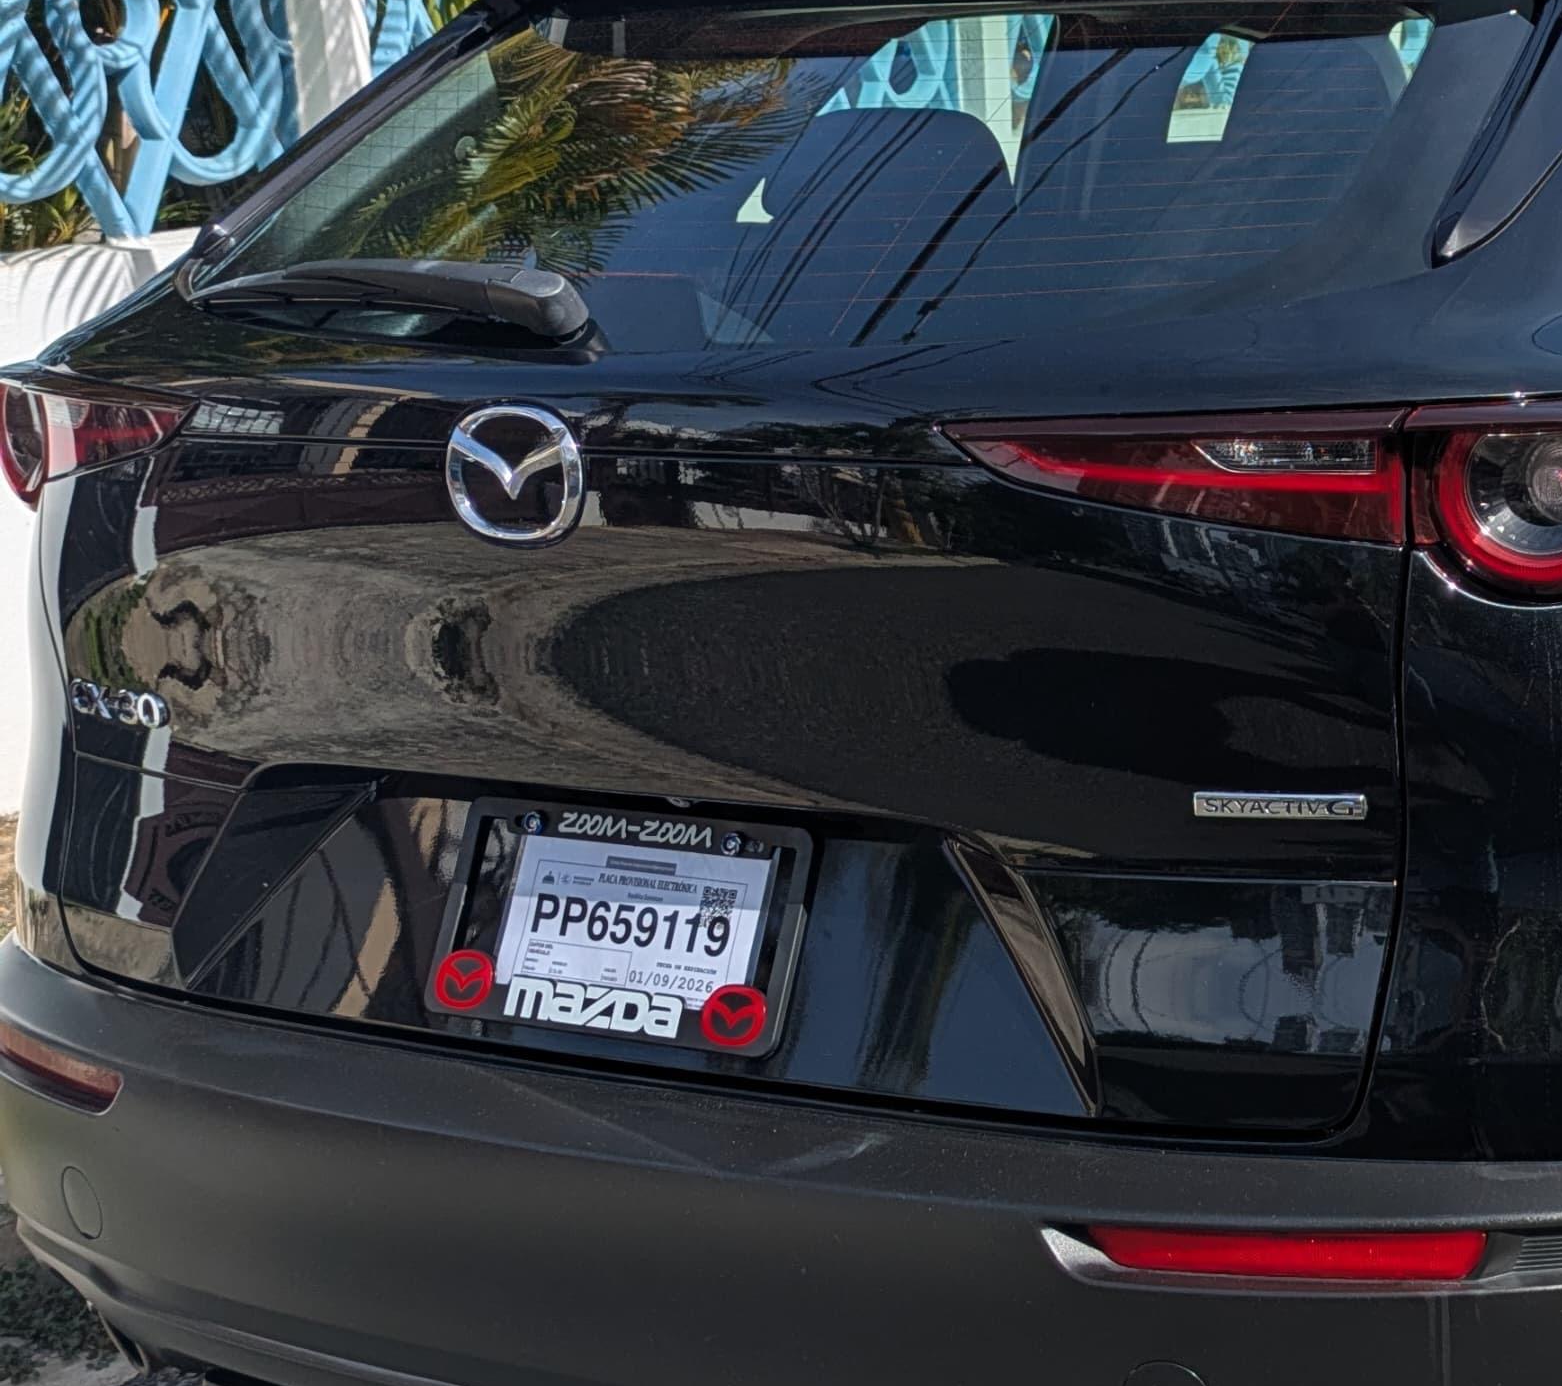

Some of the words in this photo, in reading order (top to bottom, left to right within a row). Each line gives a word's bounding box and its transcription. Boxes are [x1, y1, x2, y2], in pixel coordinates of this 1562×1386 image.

[558, 812, 712, 848] ZOOM-ZOOM
[531, 893, 731, 957] PP659119
[628, 970, 714, 993] 01/09/2026
